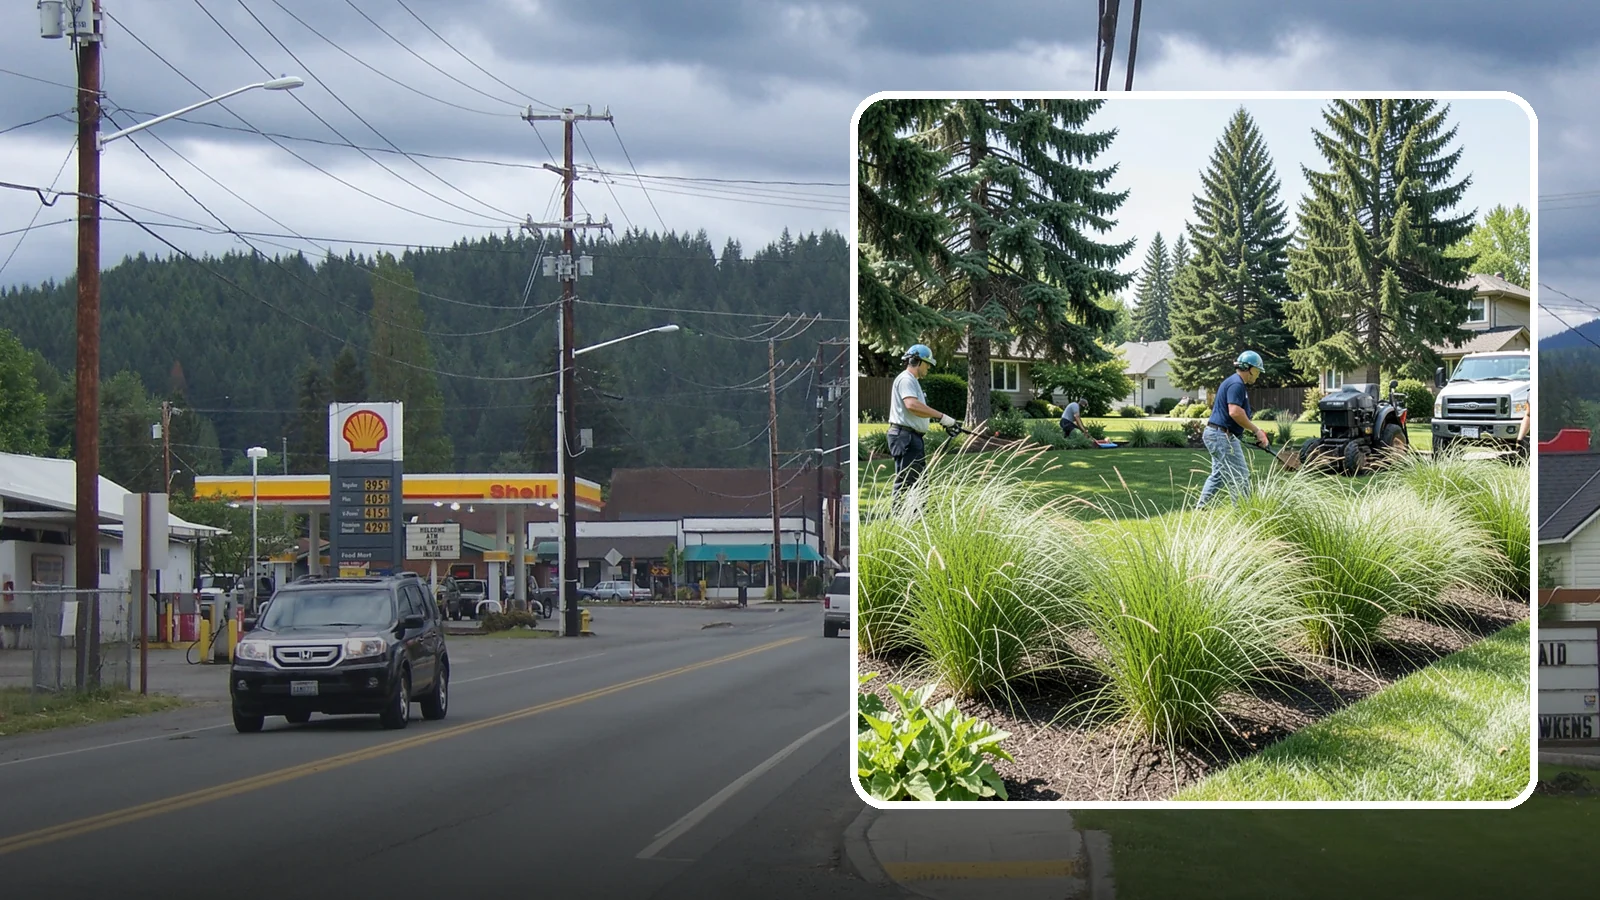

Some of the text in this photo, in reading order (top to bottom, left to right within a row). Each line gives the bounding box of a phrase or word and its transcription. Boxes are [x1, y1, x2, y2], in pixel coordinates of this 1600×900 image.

[365, 480, 383, 490] 395
[490, 484, 547, 499] Shell
[365, 494, 383, 504] 405
[365, 508, 383, 518] 415
[365, 523, 383, 533] 429
[1538, 642, 1566, 665] AID
[1538, 715, 1592, 739] WKENS
